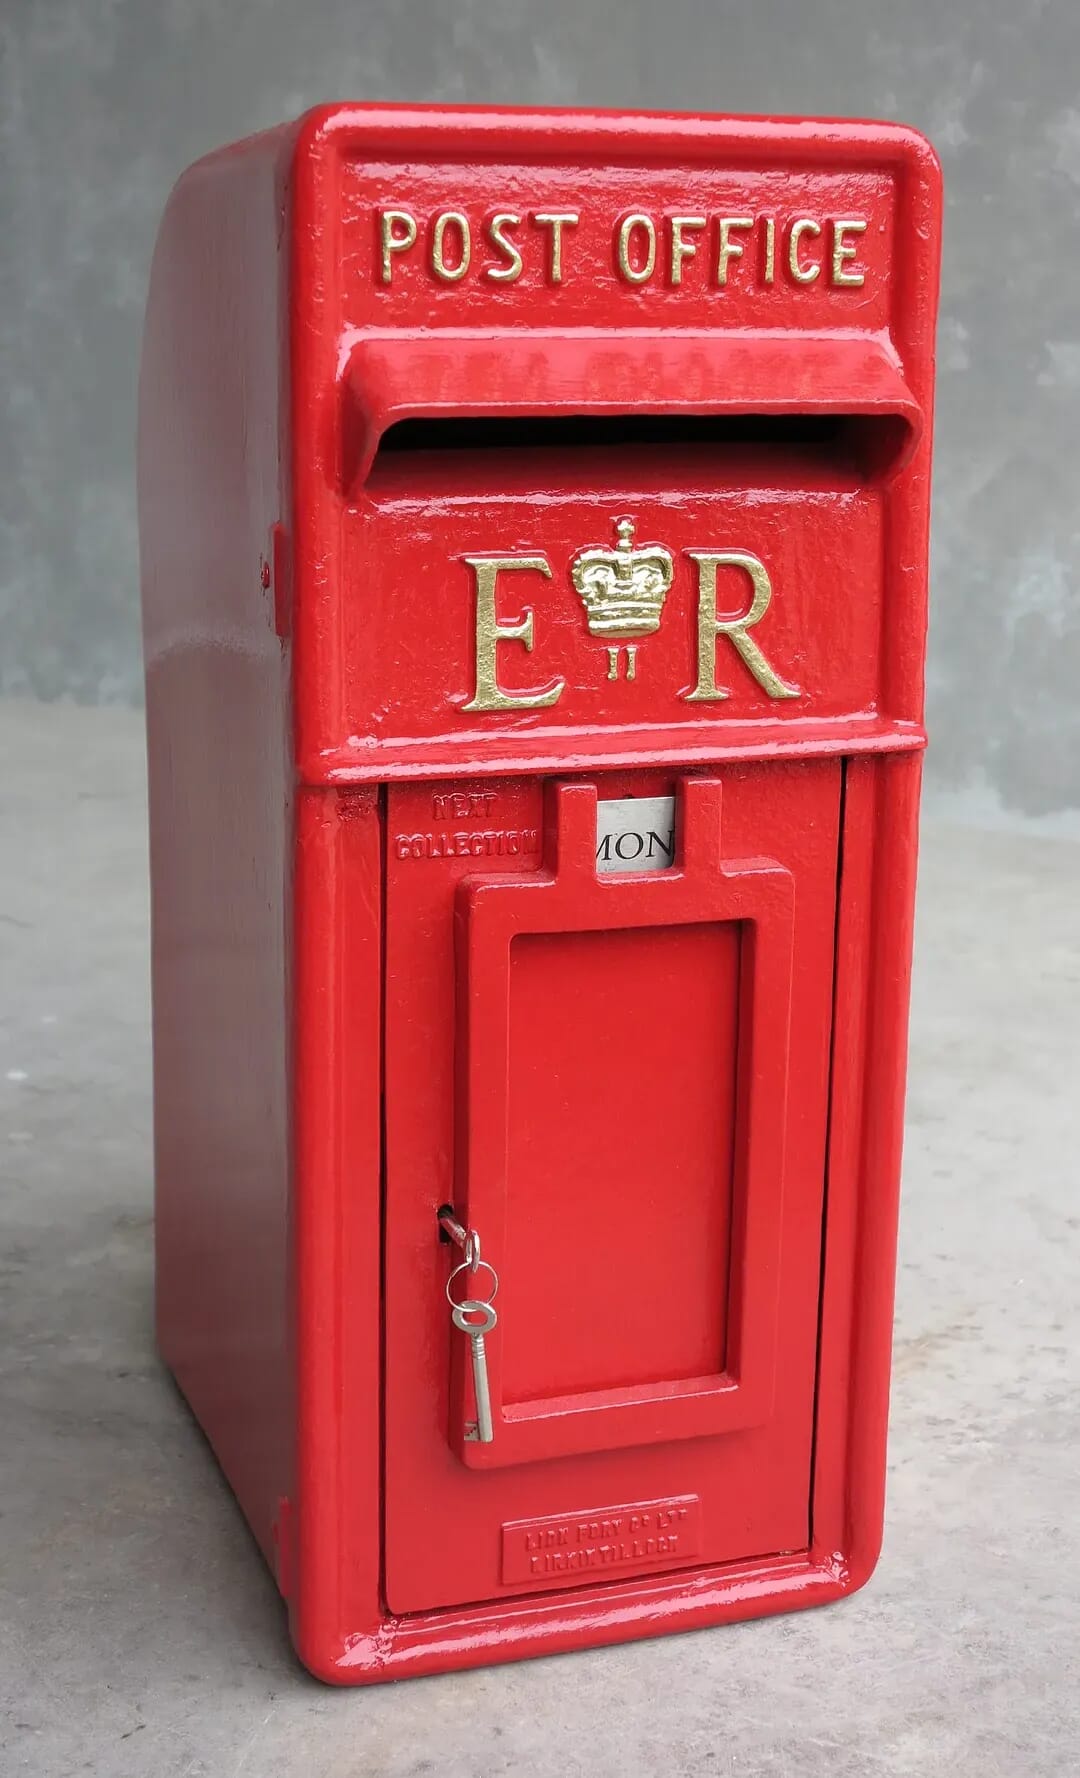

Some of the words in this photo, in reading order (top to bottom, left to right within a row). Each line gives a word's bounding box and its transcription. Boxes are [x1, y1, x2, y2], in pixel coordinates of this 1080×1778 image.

[382, 210, 579, 284] POST
[618, 214, 867, 287] OFFICE
[460, 556, 566, 712] E
[685, 552, 801, 699] R
[432, 792, 499, 820] NEXT
[394, 828, 538, 861] COLLECTION
